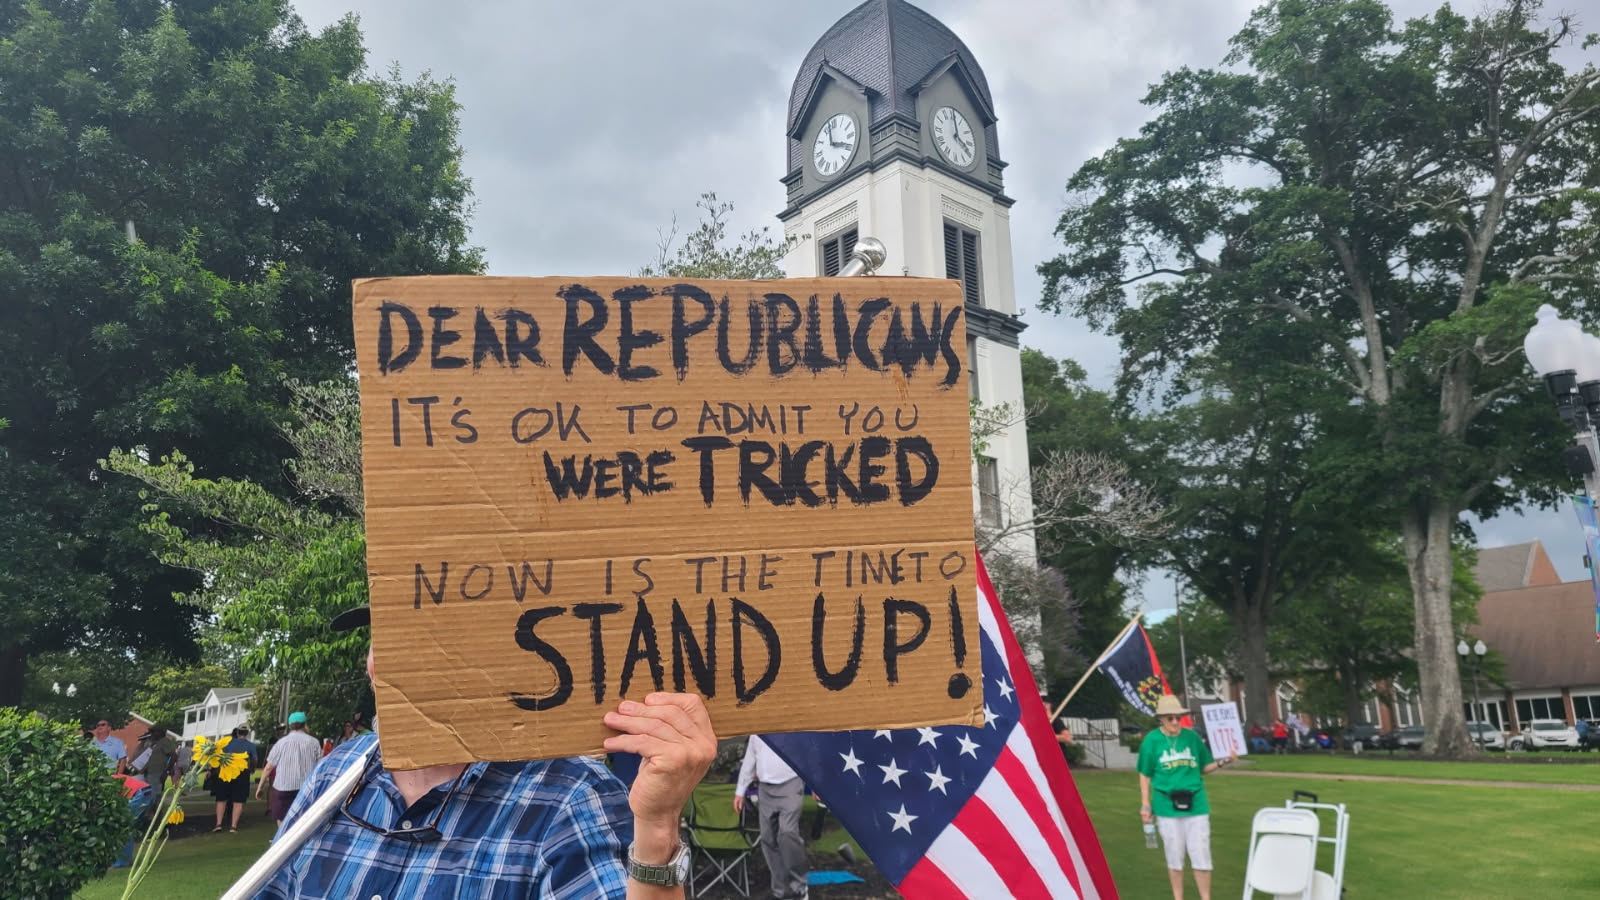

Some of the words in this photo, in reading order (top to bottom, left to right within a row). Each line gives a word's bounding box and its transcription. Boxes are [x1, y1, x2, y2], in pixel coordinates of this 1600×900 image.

[378, 300, 551, 376] DEAR
[556, 284, 965, 390] REPUBLICANS
[511, 402, 592, 443] OK
[616, 403, 678, 434] TO
[698, 400, 812, 435] ADMIT
[839, 401, 919, 435] YOU
[543, 449, 676, 504] WERE
[681, 435, 940, 509] TRICKED
[414, 558, 553, 609] NOW
[605, 558, 654, 597] IS
[685, 553, 783, 594] THE
[812, 548, 905, 587] TIME
[908, 550, 967, 580] TO
[508, 596, 782, 711] STAND
[810, 584, 973, 699] UP!
